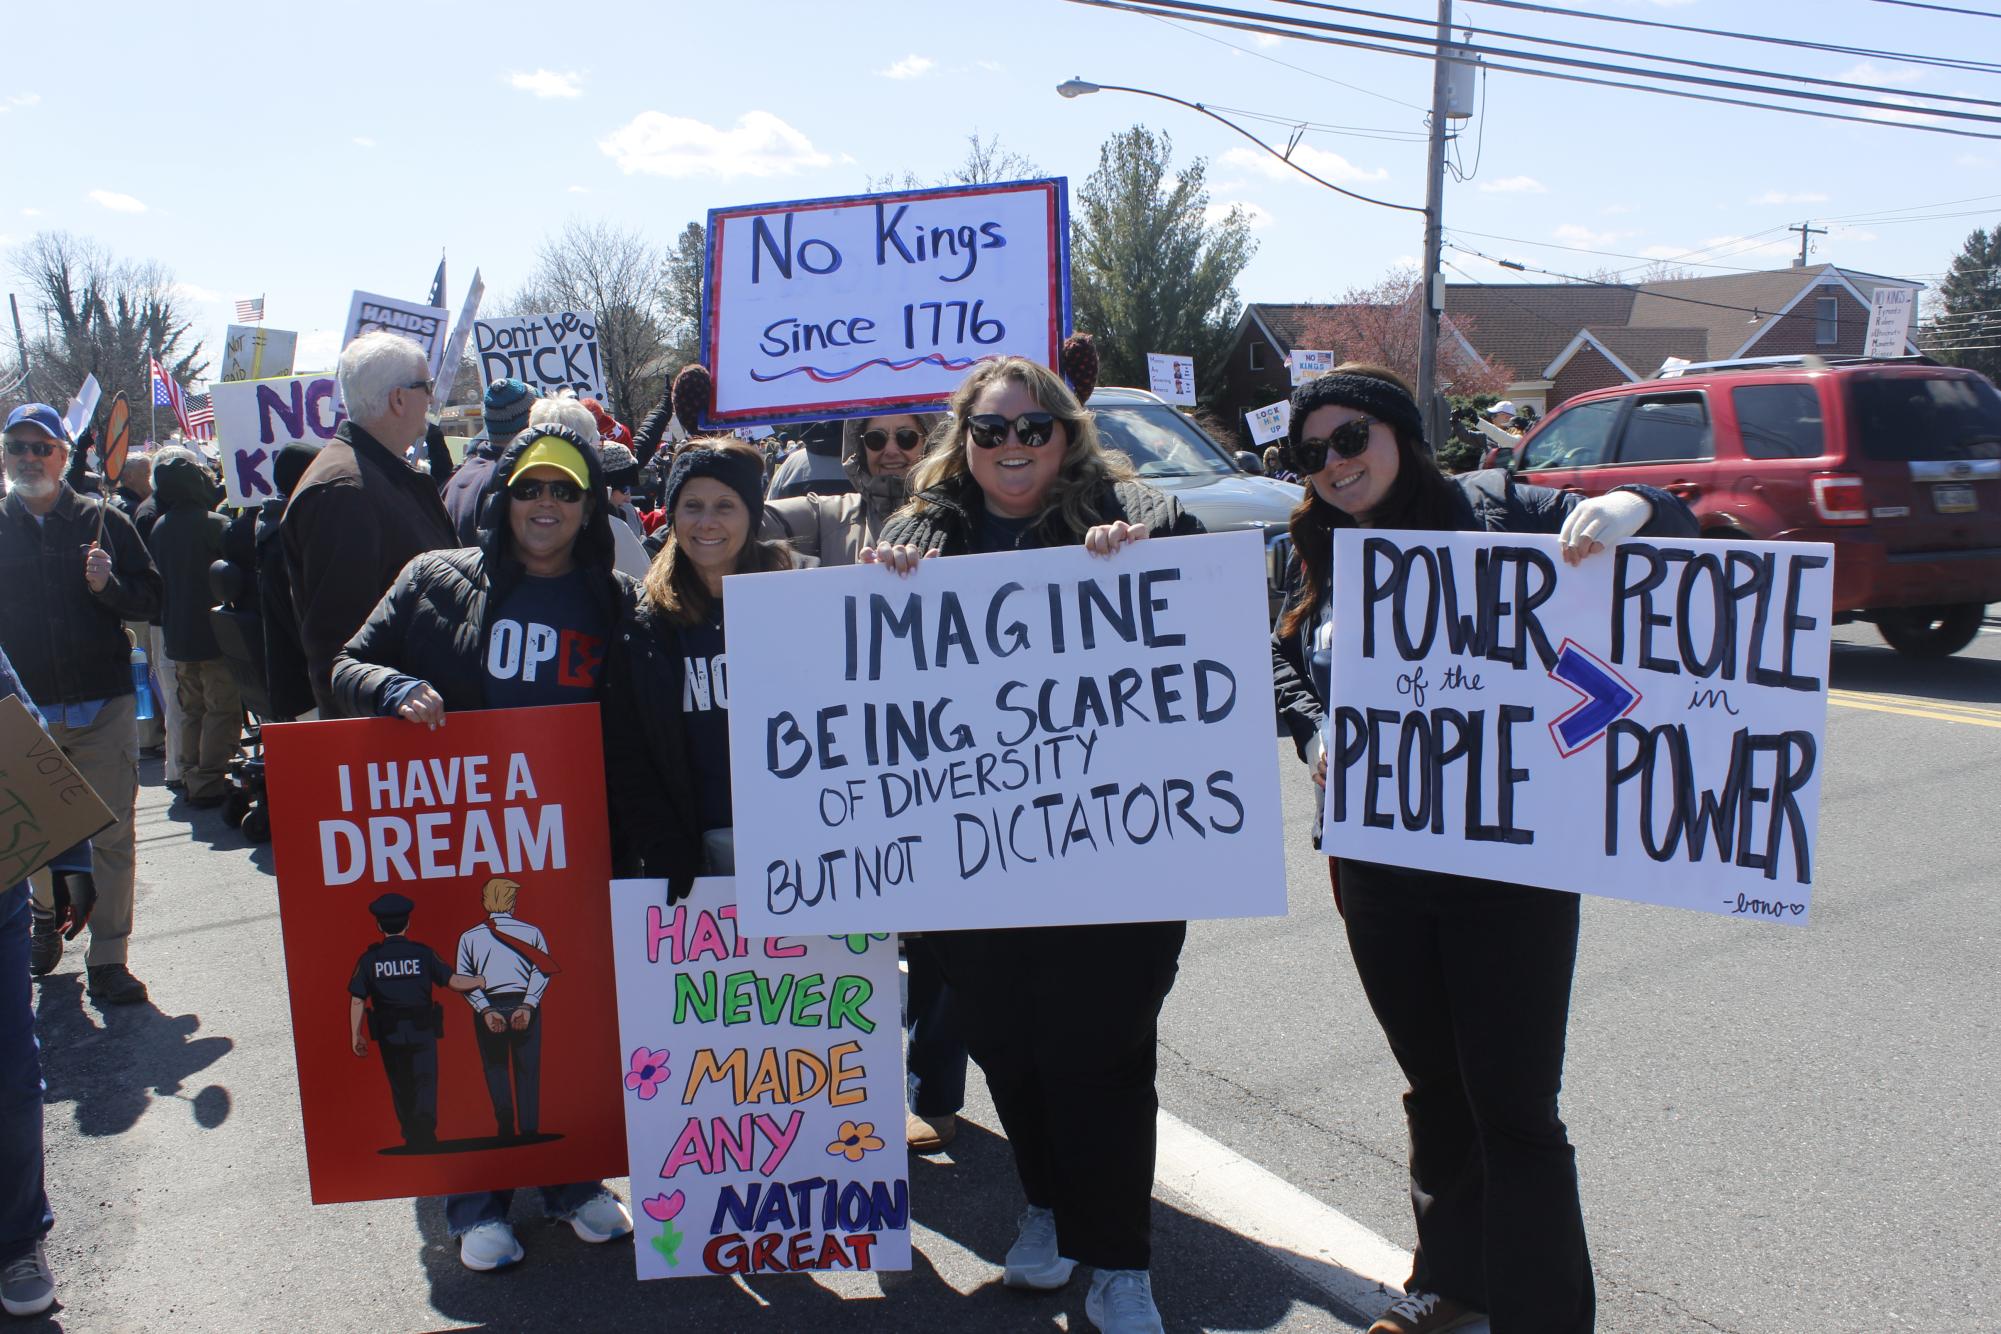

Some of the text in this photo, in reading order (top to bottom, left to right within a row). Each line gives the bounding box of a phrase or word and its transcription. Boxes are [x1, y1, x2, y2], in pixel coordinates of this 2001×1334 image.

[751, 202, 1007, 284] No Kings
[361, 304, 437, 334] HANDS
[474, 319, 543, 353] Don't
[543, 312, 581, 345] be
[904, 300, 1006, 350] 1776
[844, 568, 1186, 681] IMAGINE
[1363, 537, 1559, 671] POWER
[1610, 543, 1829, 692] PEOPLE
[766, 659, 1237, 779] BEING SCARED
[1396, 665, 1486, 707] of the
[1688, 685, 1740, 716] in
[26, 738, 89, 806] VOTE
[338, 752, 537, 812] I HAVE A
[819, 729, 1098, 827] OF DIVERSITY
[1334, 705, 1534, 845] PEOPLE
[1605, 718, 1817, 885] POWER
[318, 803, 567, 886] DREAM
[767, 770, 1245, 915] BUT NOT DICTATORS
[375, 959, 421, 979] POLICE
[672, 971, 877, 1034] NEVER
[681, 1040, 868, 1107] MADE
[659, 1110, 804, 1179] ANY
[710, 1176, 909, 1235] NATION
[702, 1232, 878, 1275] GREAT
